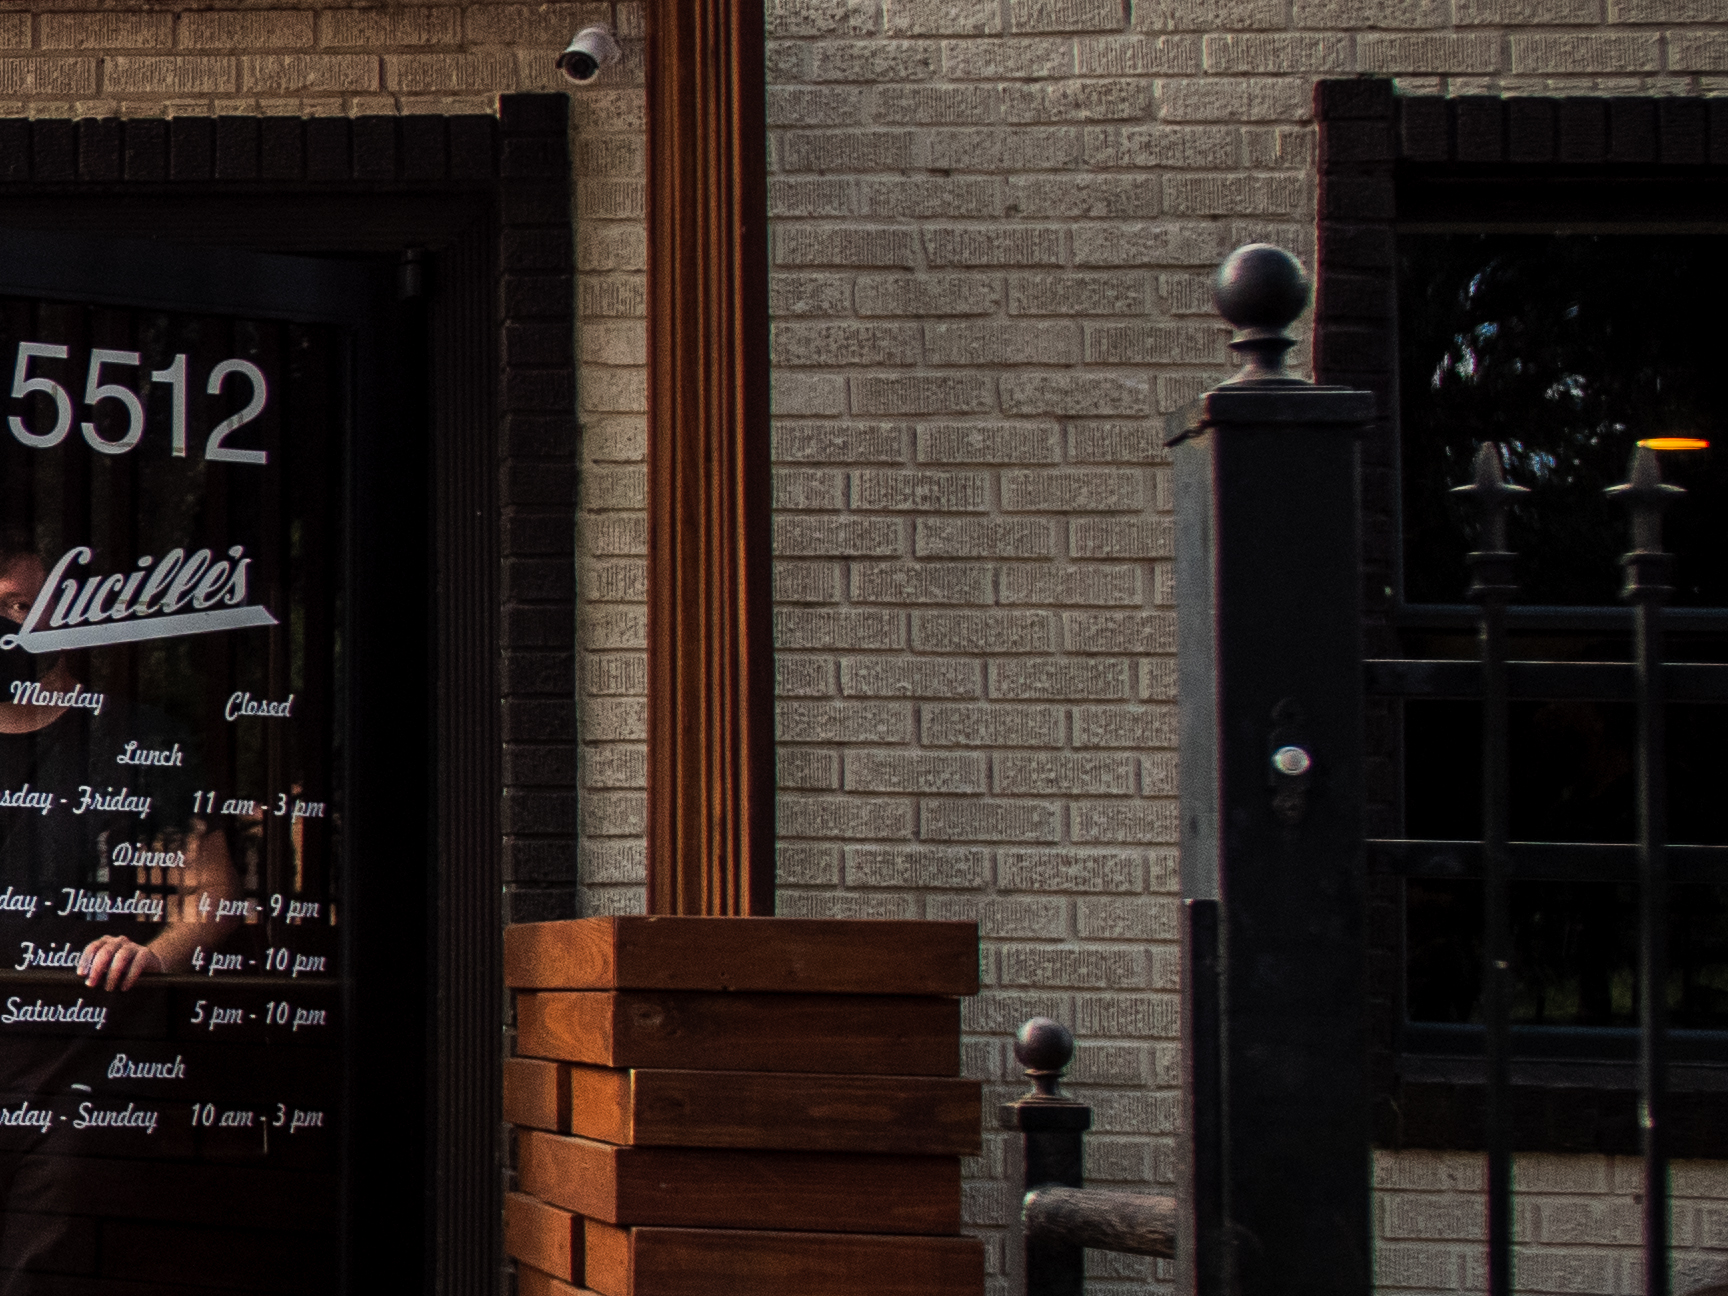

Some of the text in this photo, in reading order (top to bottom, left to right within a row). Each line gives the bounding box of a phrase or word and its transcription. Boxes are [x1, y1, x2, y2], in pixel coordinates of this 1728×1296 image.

[7, 341, 268, 465] 5512
[0, 545, 280, 654] Lucille's
[11, 681, 294, 721] Monday Closed
[117, 741, 182, 766] Lunch
[73, 786, 151, 819] Friday
[194, 791, 215, 813] 11
[221, 800, 255, 815] am
[274, 793, 286, 815] 3
[292, 800, 323, 823] pm
[112, 842, 186, 867] Dinner
[58, 888, 163, 921] Thursday
[199, 892, 211, 917] 4
[215, 898, 252, 922] pm
[271, 894, 282, 916] 9
[286, 901, 318, 923] pm
[192, 946, 204, 970] 4
[209, 952, 242, 976] pm
[266, 948, 288, 970] 10
[292, 954, 325, 977] pm
[1, 996, 107, 1029] Saturday
[191, 1000, 206, 1023] 5
[209, 1007, 242, 1030] pm
[267, 1002, 288, 1024] 10
[293, 1008, 325, 1031] pm
[108, 1054, 184, 1079] Brunch
[73, 1102, 157, 1134] Sunday
[192, 1104, 214, 1126] 10
[220, 1112, 252, 1126] am
[273, 1104, 284, 1126] 3
[291, 1111, 322, 1133] pm
